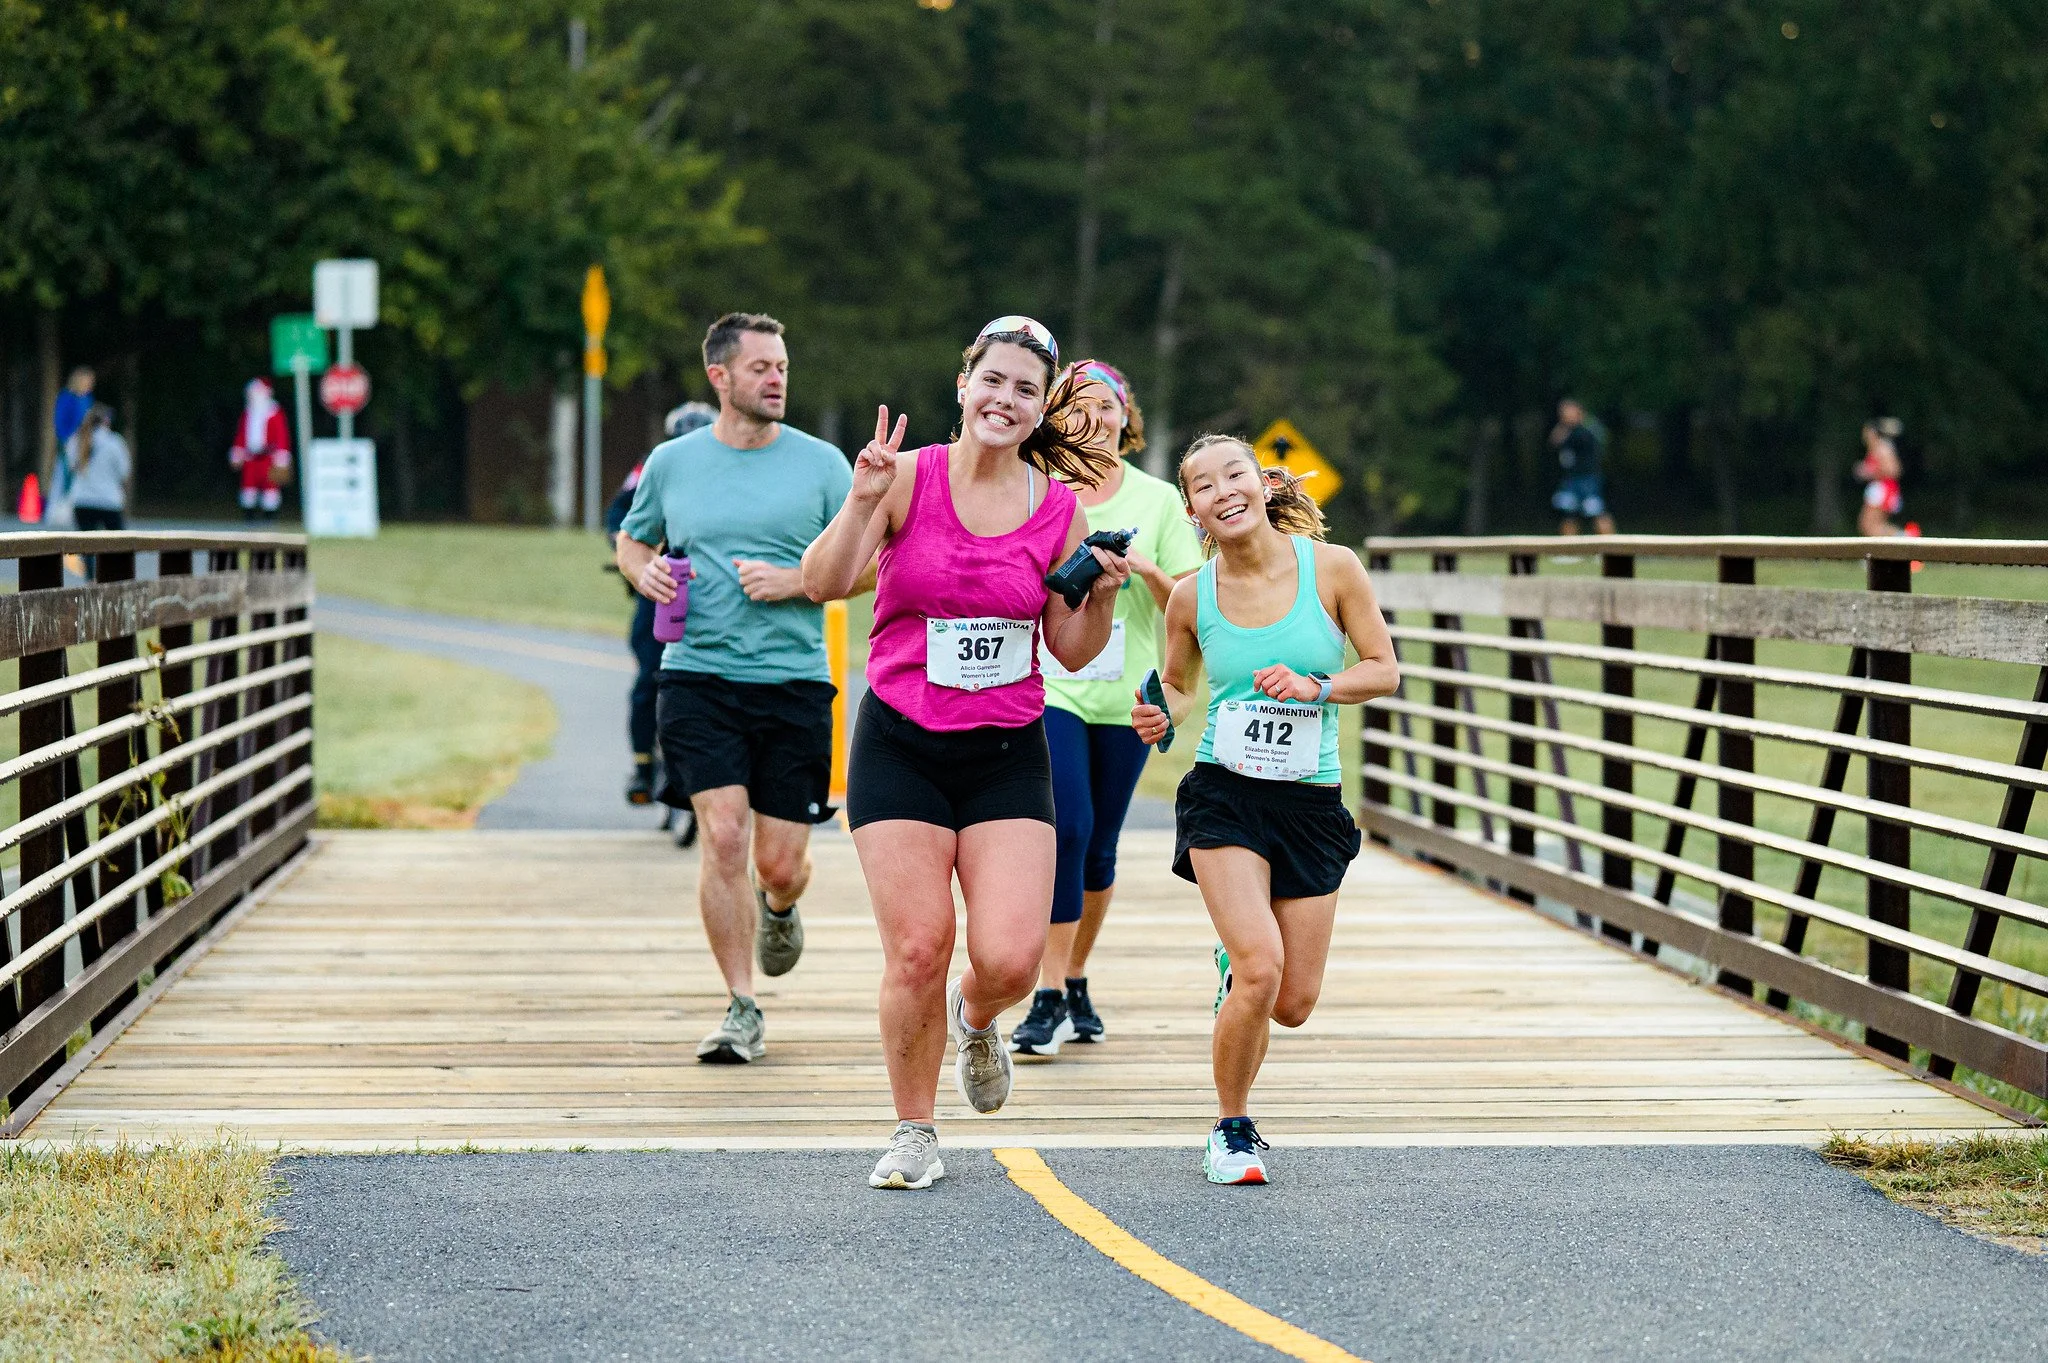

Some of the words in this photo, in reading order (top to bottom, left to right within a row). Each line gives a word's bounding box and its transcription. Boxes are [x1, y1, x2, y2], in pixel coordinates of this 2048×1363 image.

[954, 623, 968, 631] VA
[970, 622, 1029, 631] MOMENTUM
[957, 636, 1005, 661] 367
[1244, 703, 1258, 713] VA
[1259, 705, 1318, 719] MOMENTUM
[1244, 719, 1293, 746] 412
[1244, 746, 1270, 754] Elizabeth
[1245, 753, 1271, 762] Women's
[1271, 756, 1287, 764] Small
